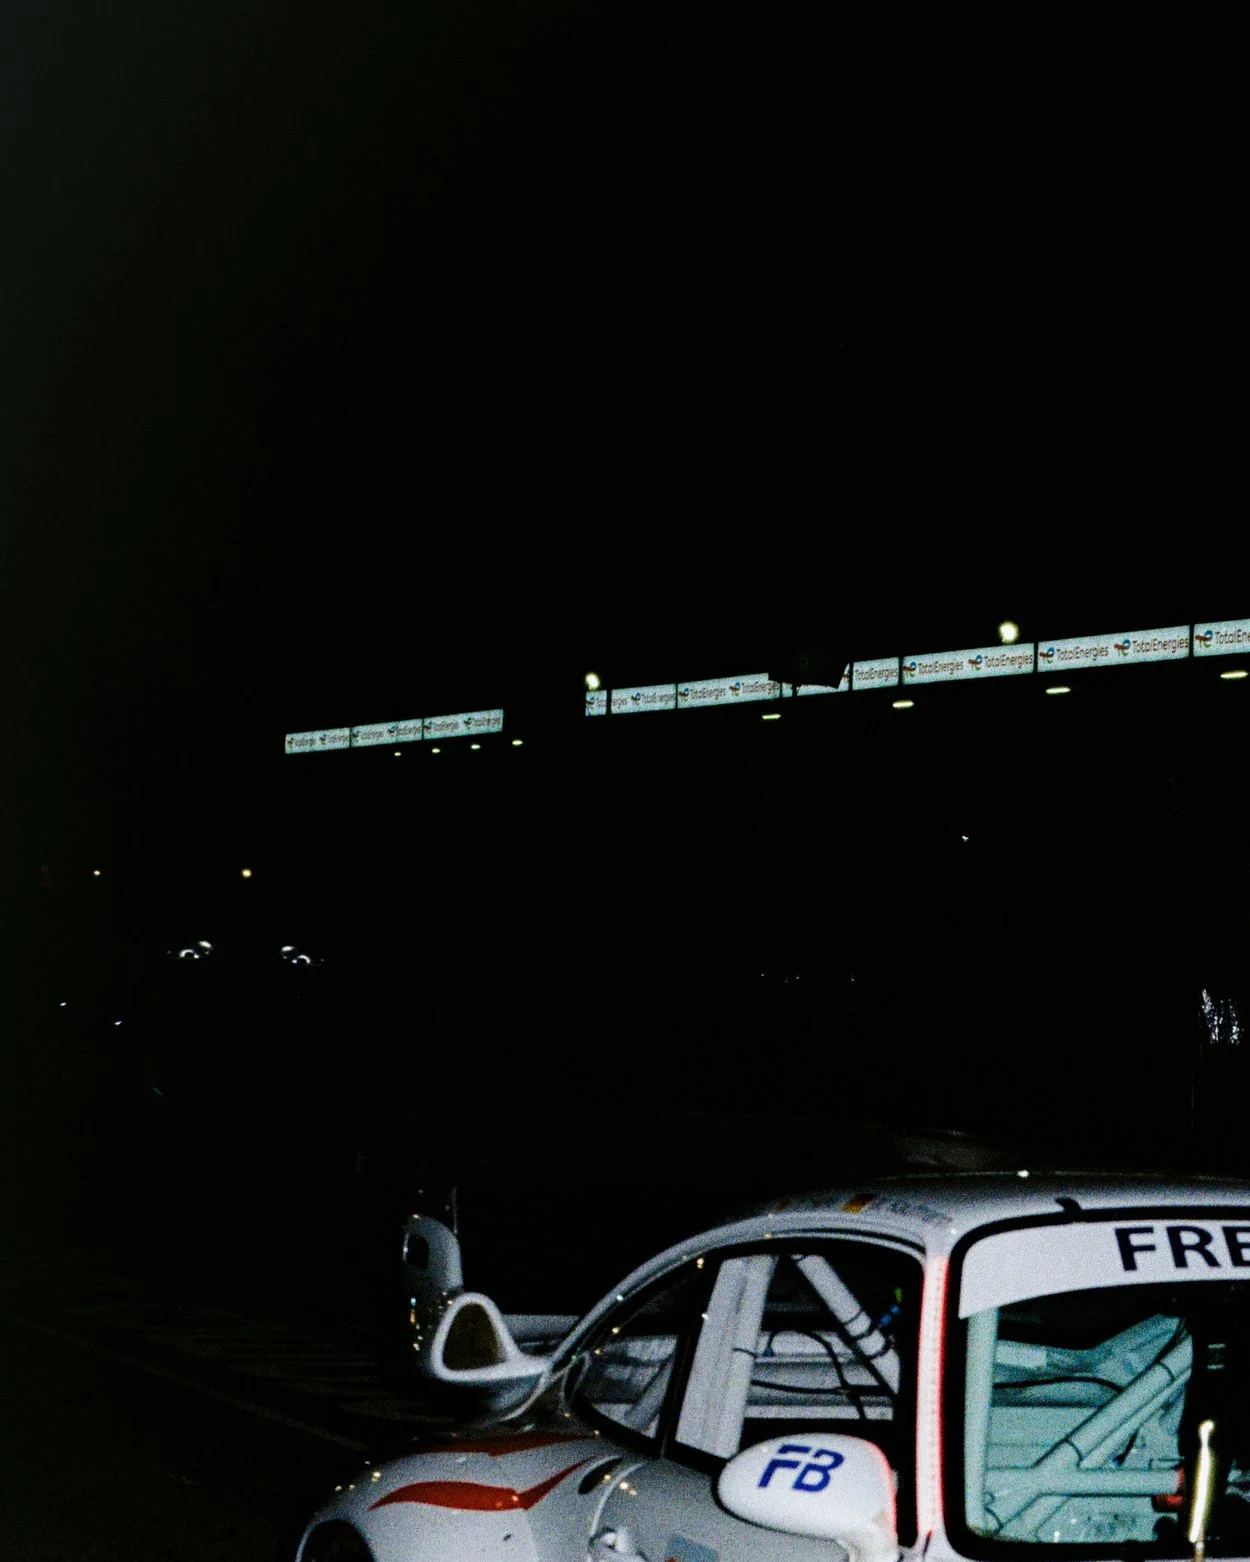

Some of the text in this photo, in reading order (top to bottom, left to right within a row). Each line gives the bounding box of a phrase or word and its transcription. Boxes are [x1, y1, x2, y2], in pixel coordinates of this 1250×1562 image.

[1055, 645, 1110, 663] TotalEnergies
[1132, 636, 1190, 655] TotalEnergies
[918, 660, 965, 676] TotalEnergies
[983, 653, 1034, 671] TotalEnergies
[854, 665, 899, 682] TotalEnergies
